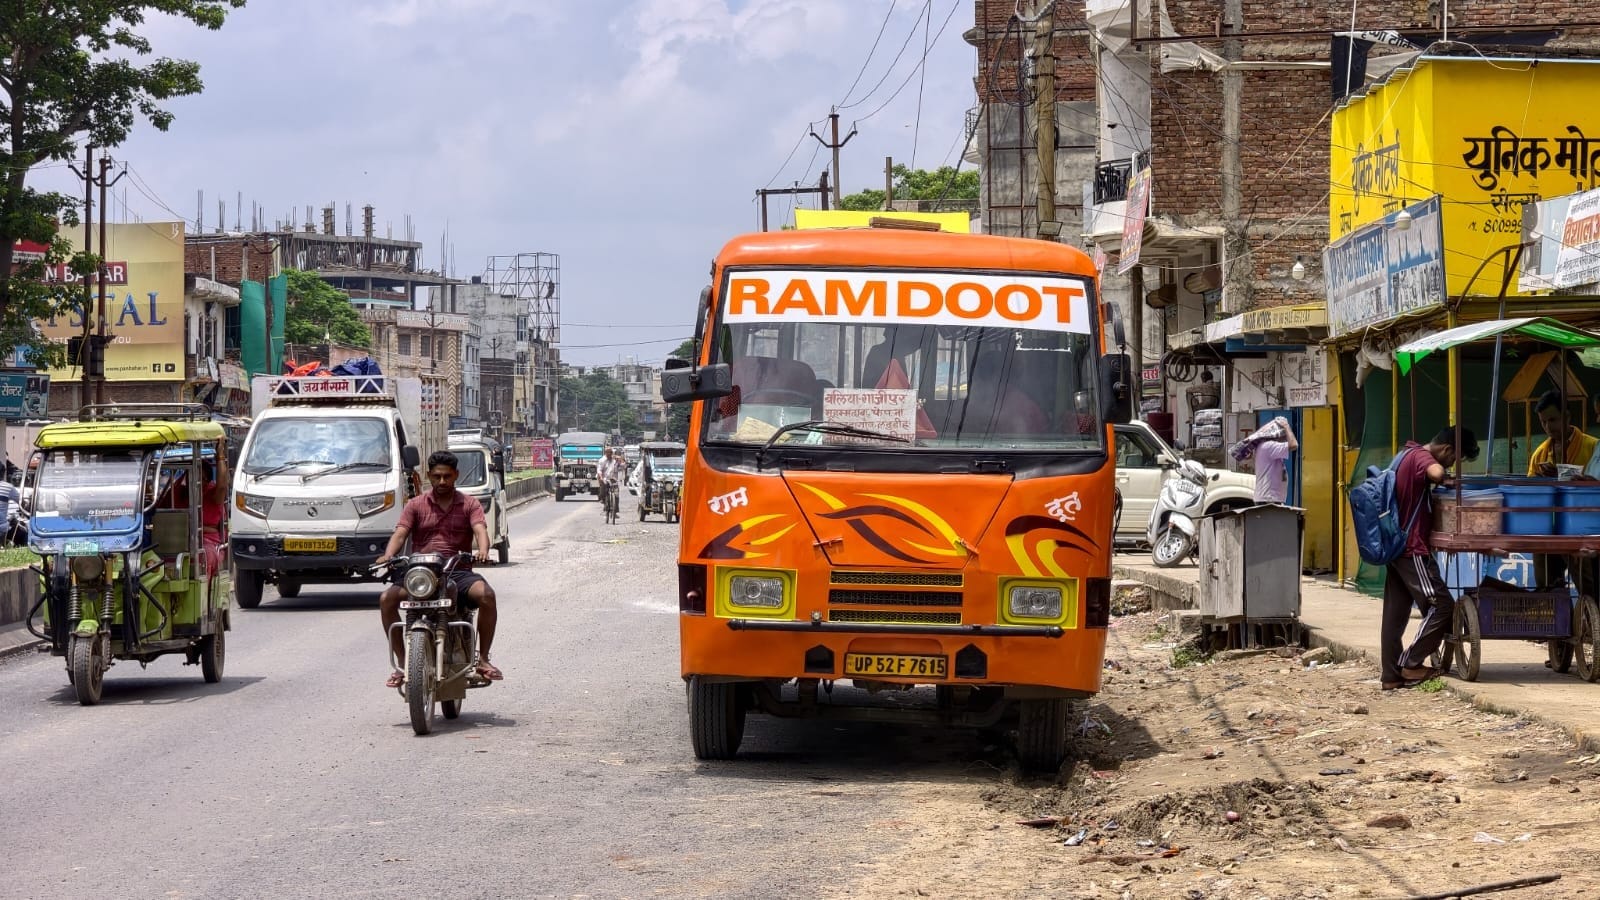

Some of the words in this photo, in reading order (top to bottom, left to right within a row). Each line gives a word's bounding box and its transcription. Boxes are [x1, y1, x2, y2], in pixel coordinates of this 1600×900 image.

[728, 278, 1084, 324] RAMDOOT
[707, 487, 748, 515] राम
[1044, 491, 1082, 523] दूत
[855, 656, 873, 672] UP
[877, 657, 894, 673] 52
[897, 658, 906, 673] F
[910, 658, 944, 674] 7615
